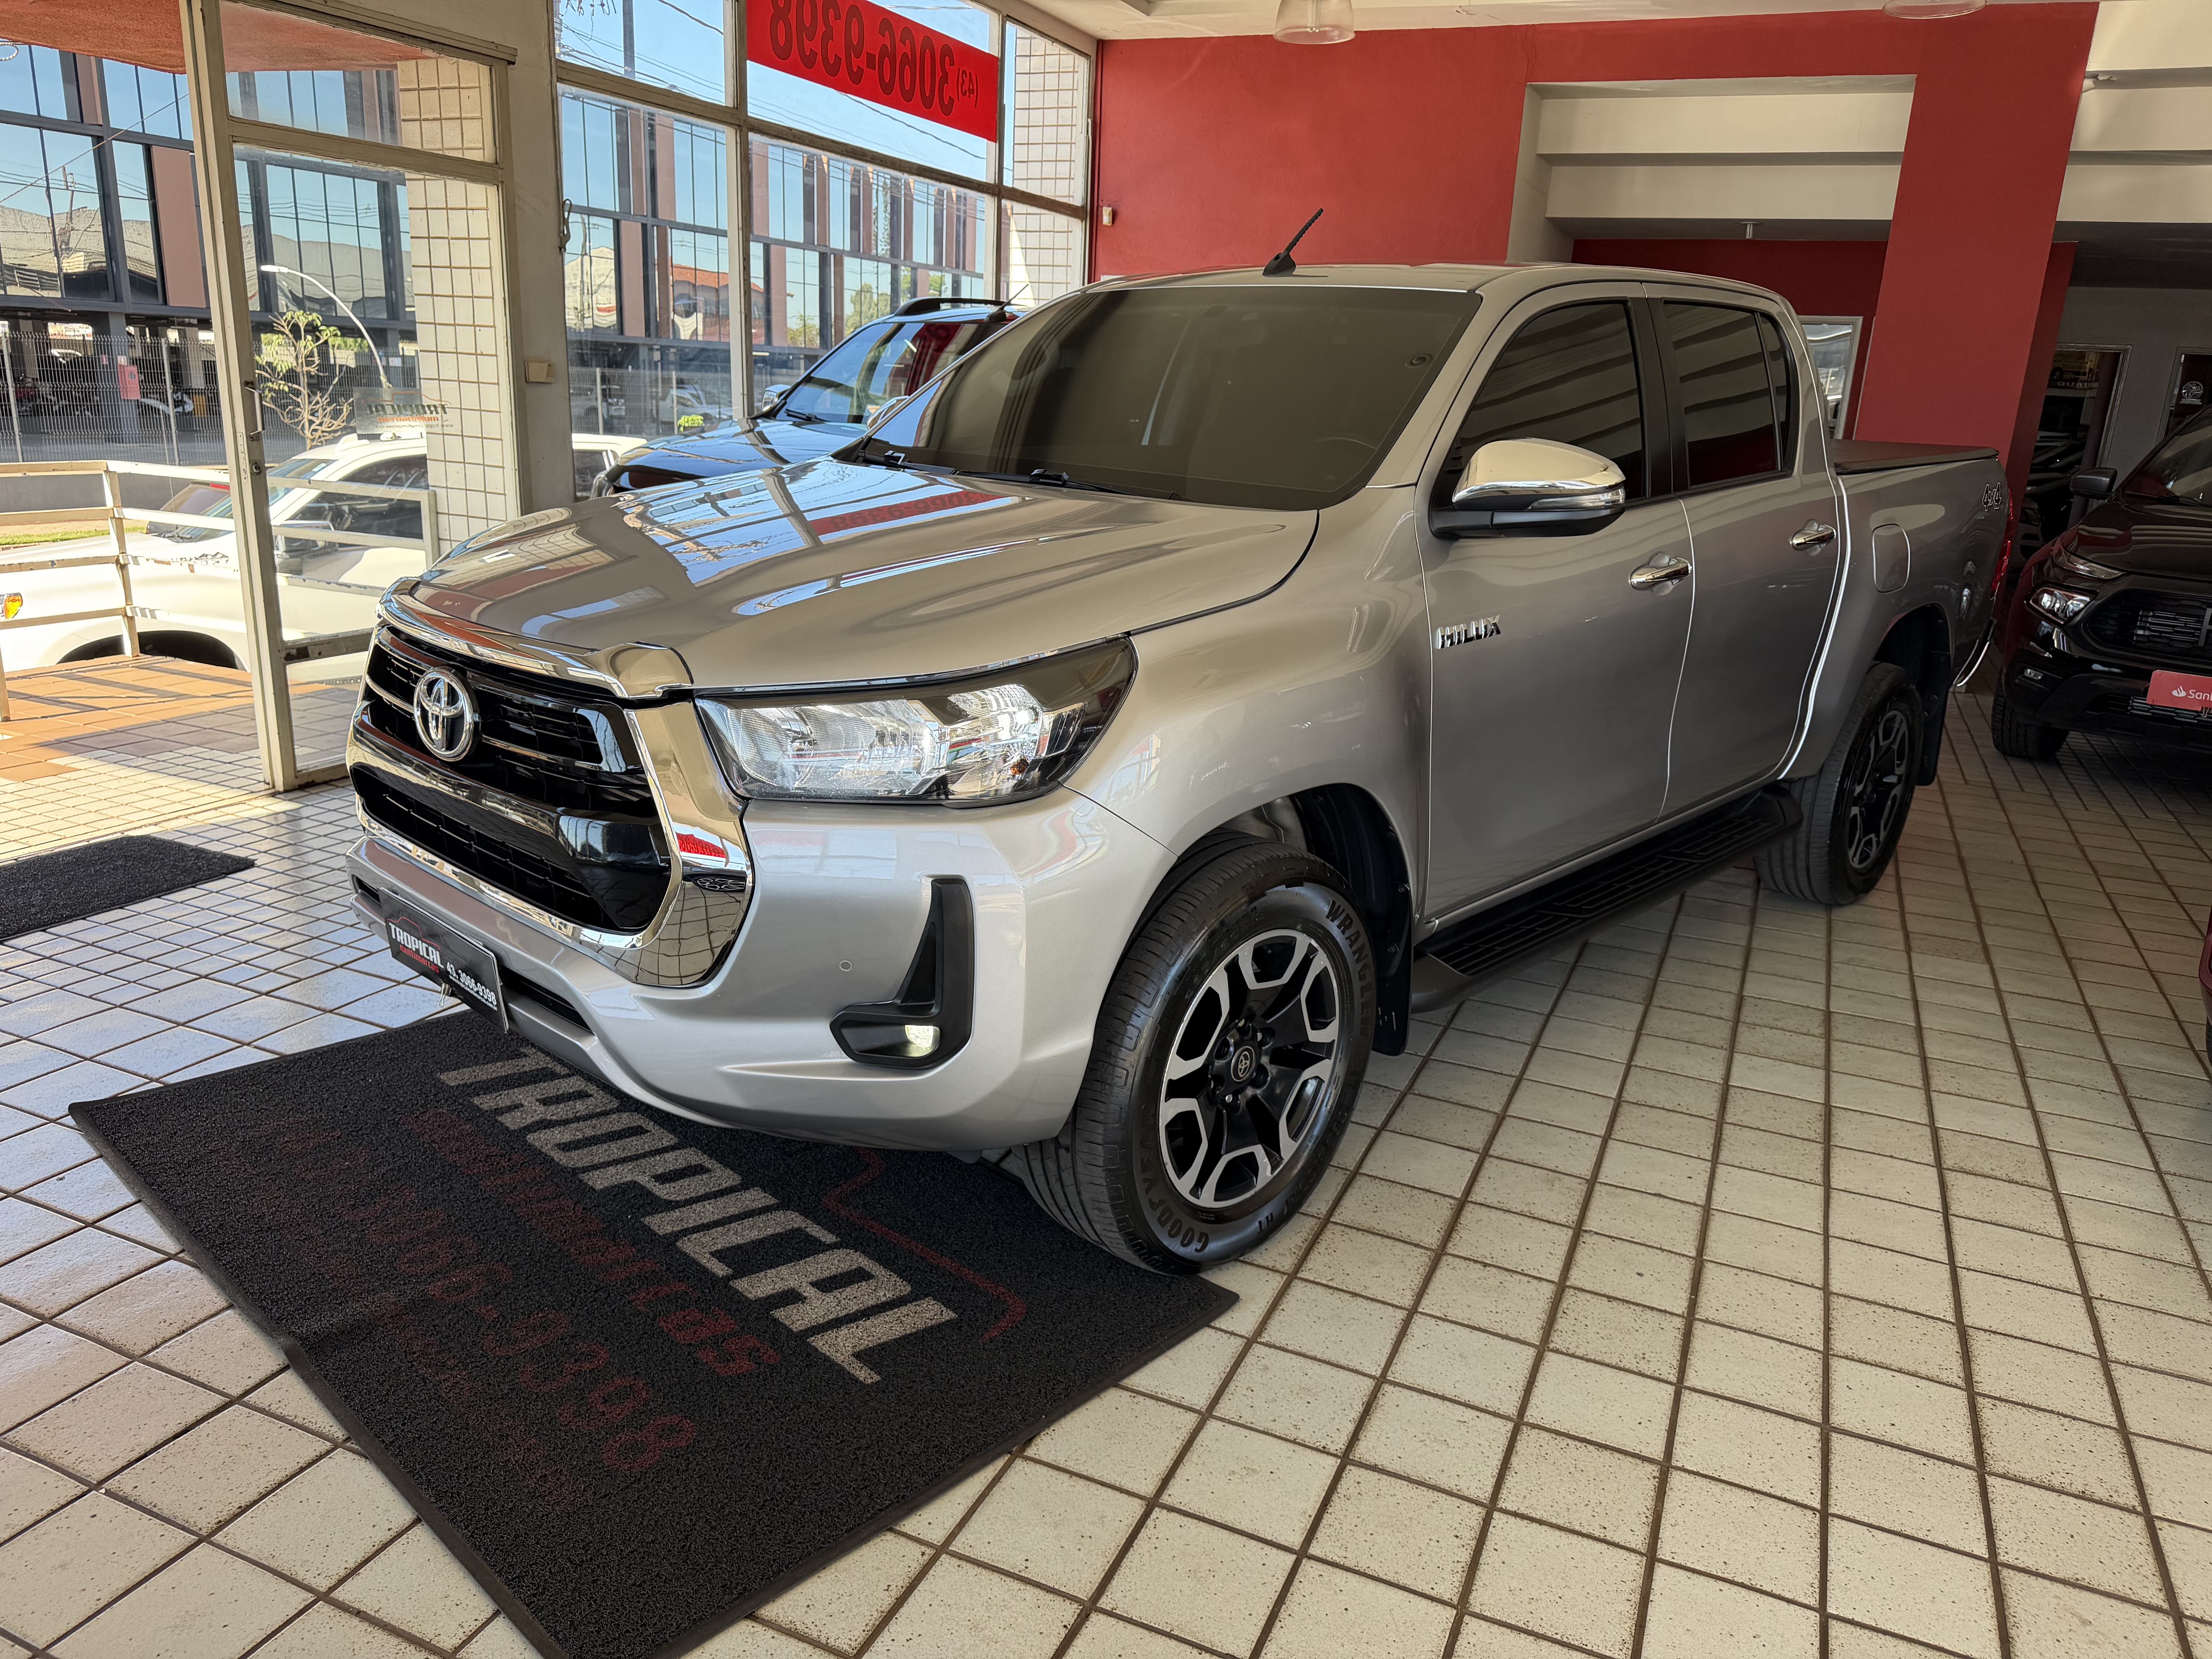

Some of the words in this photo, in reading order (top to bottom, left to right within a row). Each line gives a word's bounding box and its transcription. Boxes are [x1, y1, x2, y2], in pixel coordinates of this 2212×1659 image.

[1982, 482, 2002, 511] 4x4
[1436, 615, 1509, 649] HILUX
[389, 922, 444, 969] TROPICAL
[399, 944, 440, 974] multimarcas
[459, 969, 497, 1005] 3066-9398
[1326, 899, 1375, 1036] WRANGLER
[1139, 1101, 1209, 1253] GOODYEAR
[438, 1046, 958, 1384] TROPICAL
